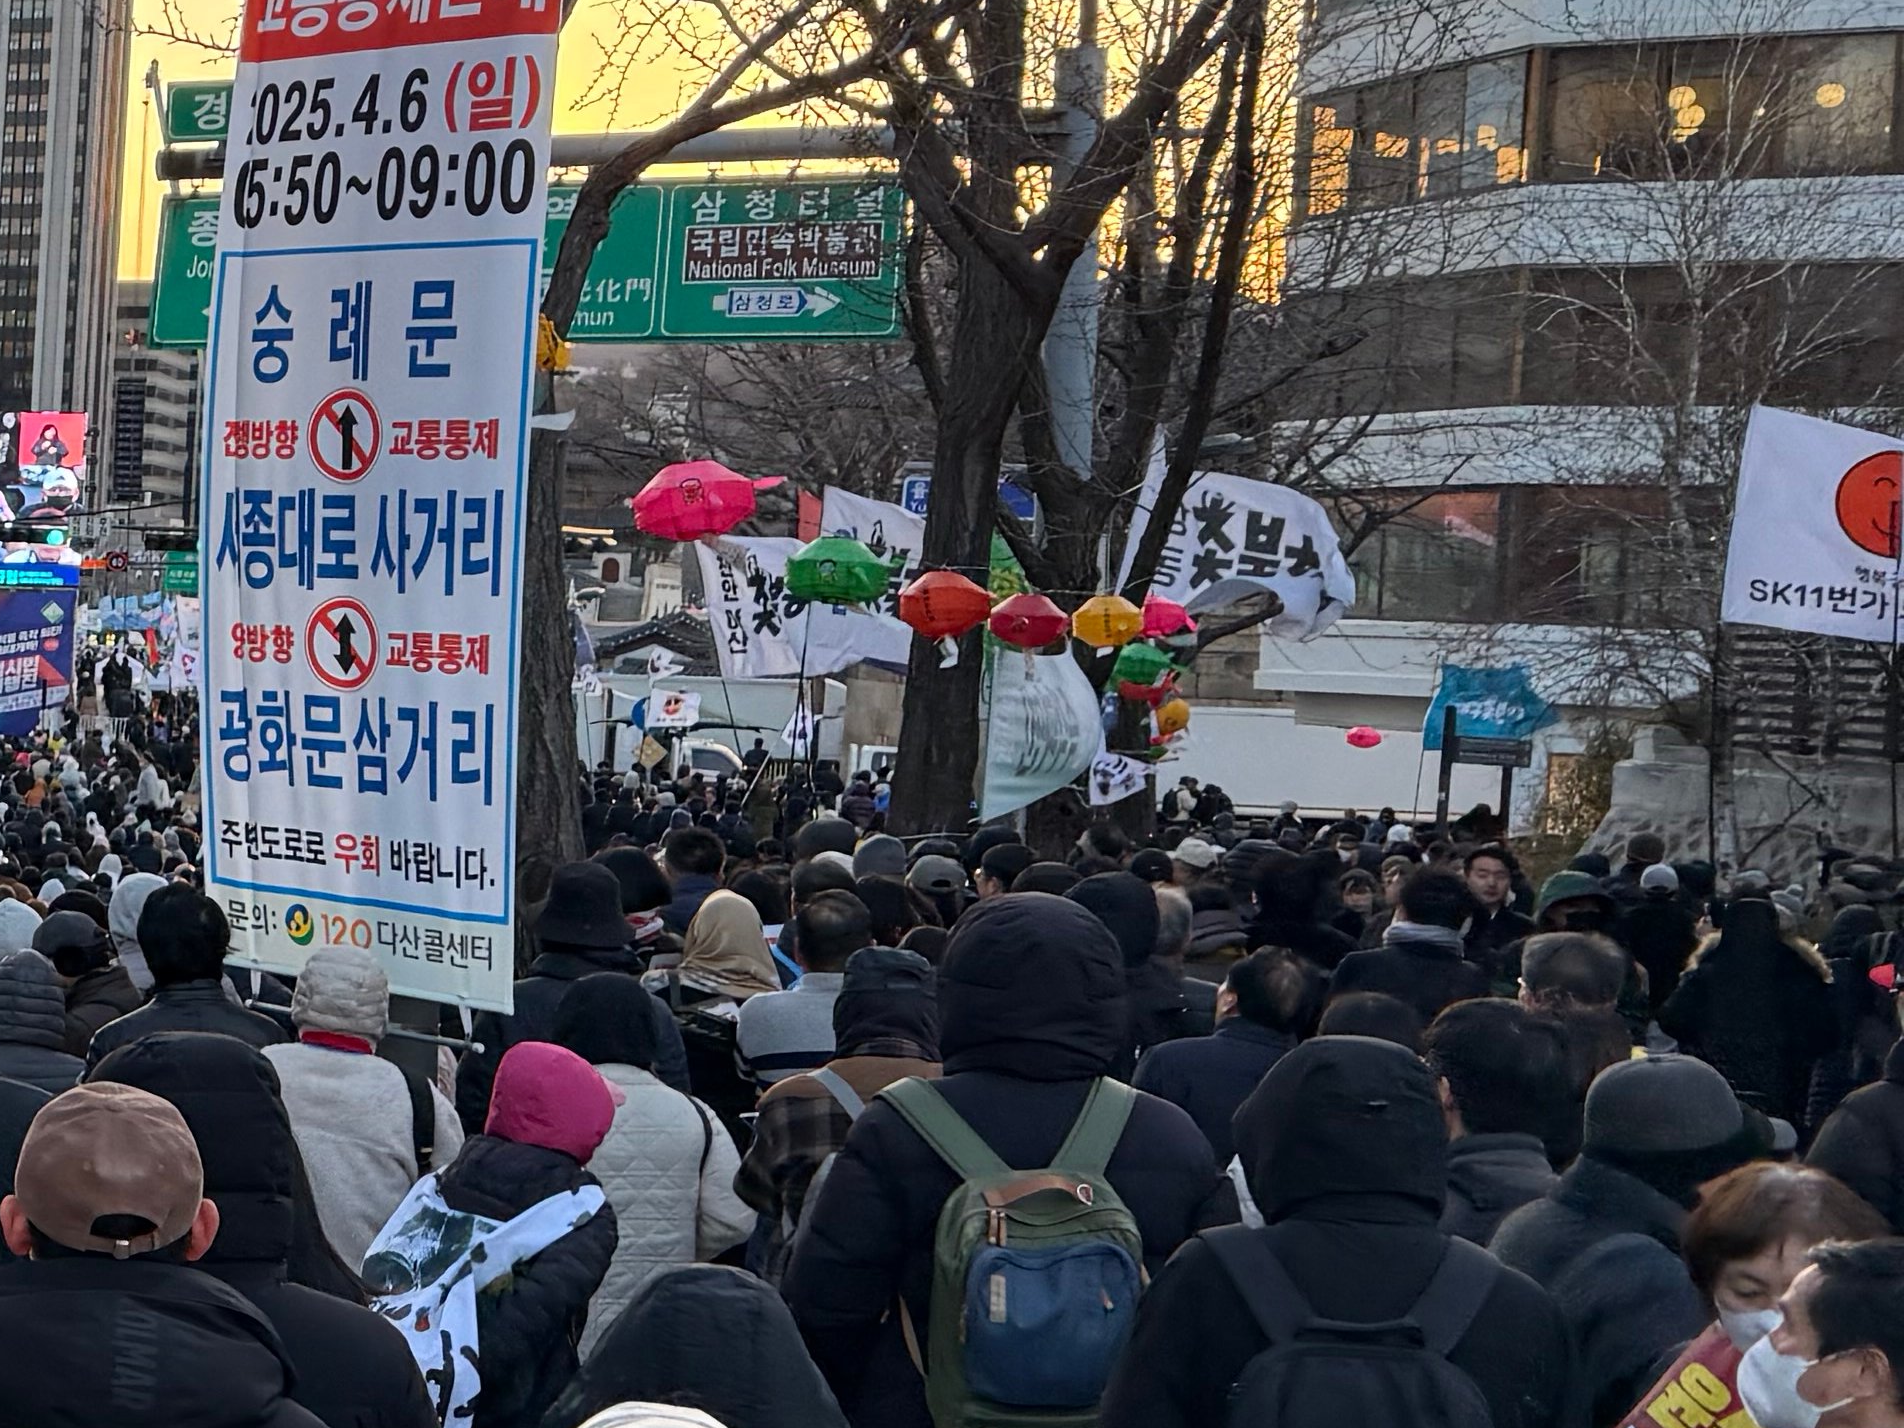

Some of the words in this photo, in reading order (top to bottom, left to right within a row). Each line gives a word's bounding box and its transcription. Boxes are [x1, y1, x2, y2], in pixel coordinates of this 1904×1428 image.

[443, 55, 542, 134] (일)
[689, 258, 758, 280] National
[762, 257, 798, 278] Folk
[389, 418, 500, 461] 교통통제
[370, 487, 505, 597] 사거리
[1748, 578, 1891, 620] SK11번가
[385, 632, 490, 676] 교통통제
[219, 687, 496, 807] 광화문삼거리
[220, 819, 327, 866] 주변도로로
[333, 834, 382, 878] 우회
[390, 839, 497, 892] 바랍니다.
[320, 913, 374, 950] 120
[376, 920, 494, 972] 다산콜센터
